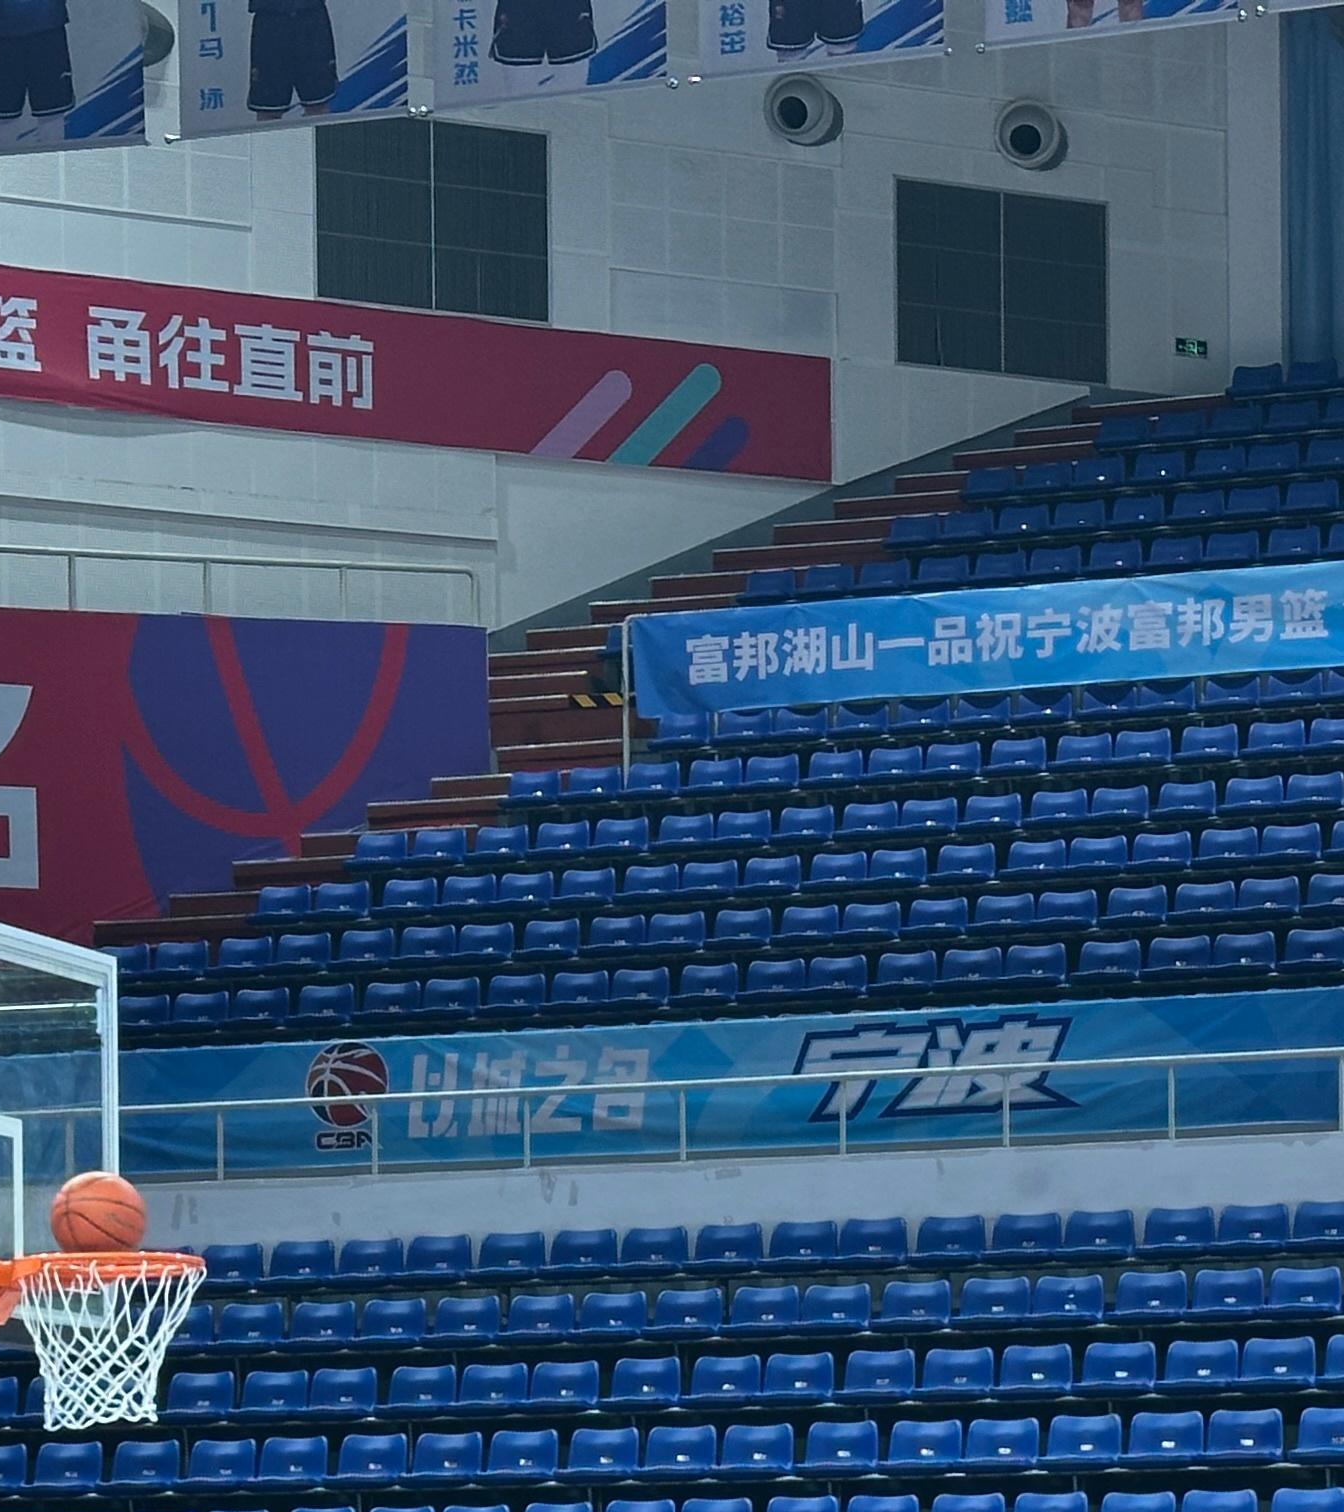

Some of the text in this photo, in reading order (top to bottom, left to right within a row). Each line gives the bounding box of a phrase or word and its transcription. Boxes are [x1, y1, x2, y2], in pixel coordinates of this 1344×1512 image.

[684, 588, 1329, 686] 富邦湖山一品祝宁波富邦男篮
[406, 1044, 651, 1140] 以城之名
